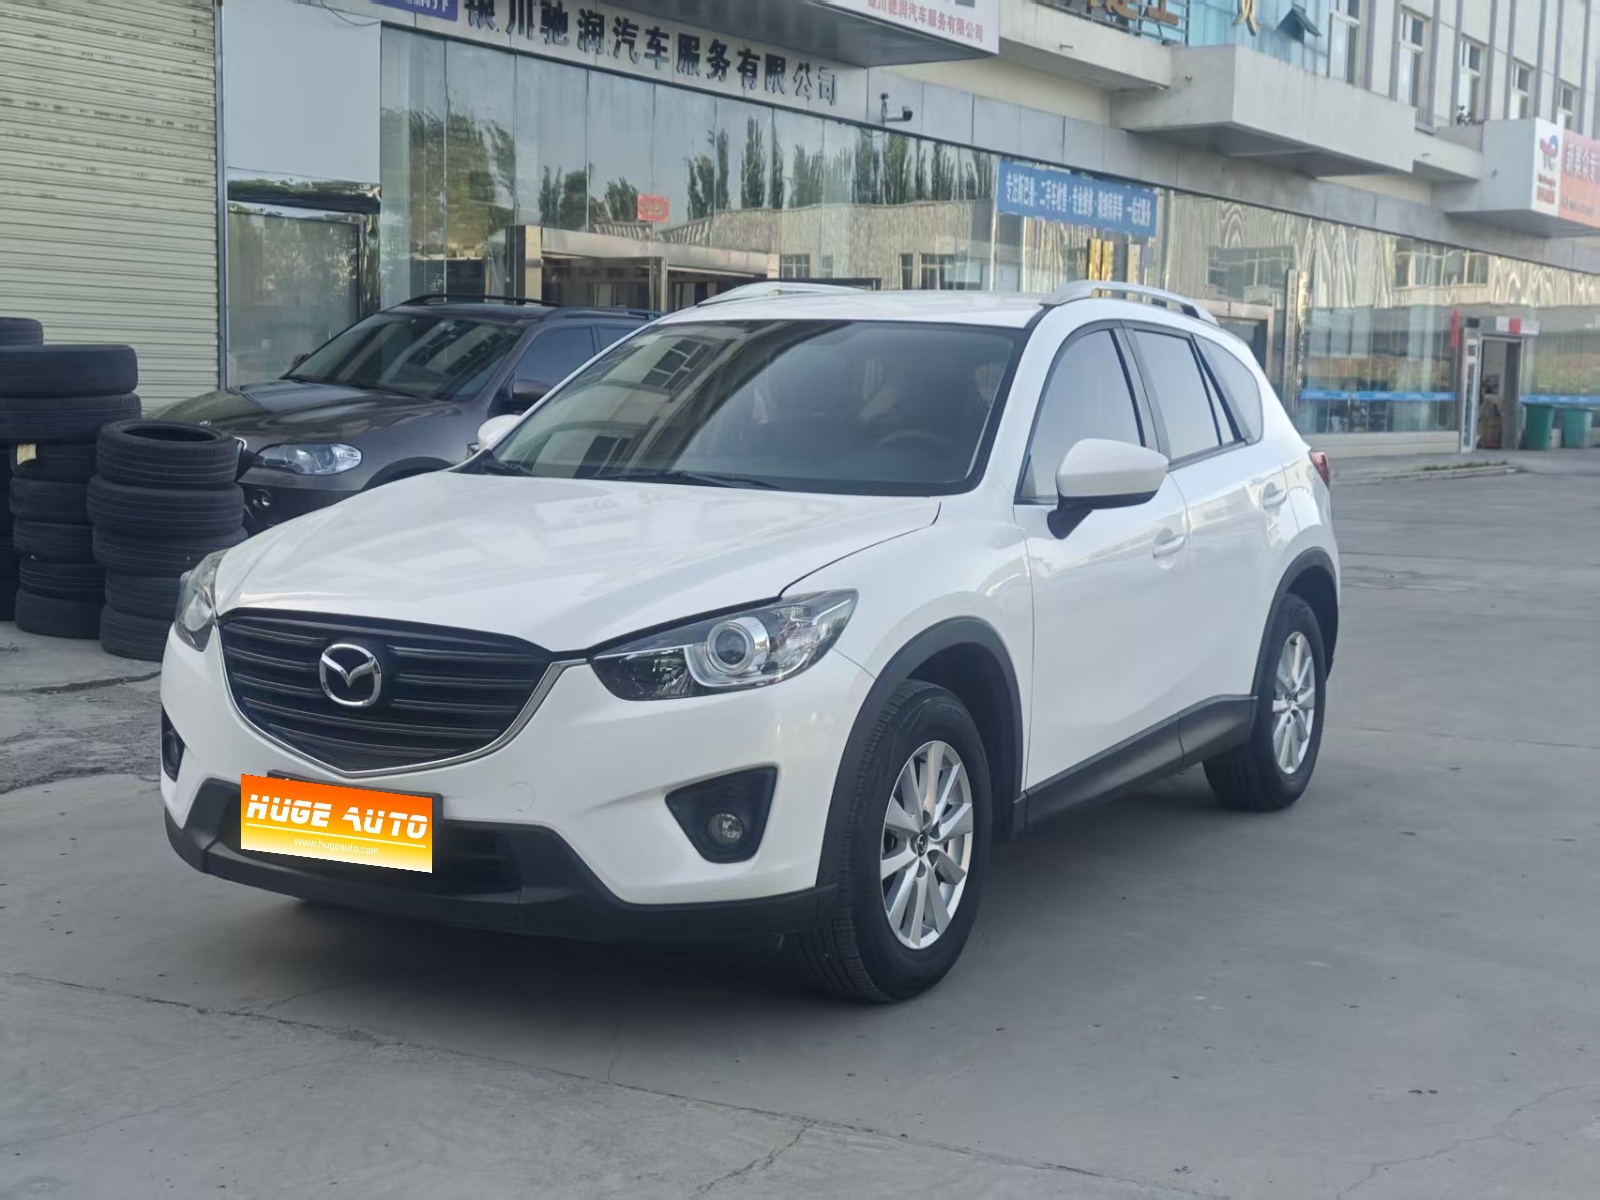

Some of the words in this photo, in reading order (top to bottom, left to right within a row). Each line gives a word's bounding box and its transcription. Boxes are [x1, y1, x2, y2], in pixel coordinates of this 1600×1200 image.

[463, 0, 838, 106] 银川驰润汽车服务有限公司
